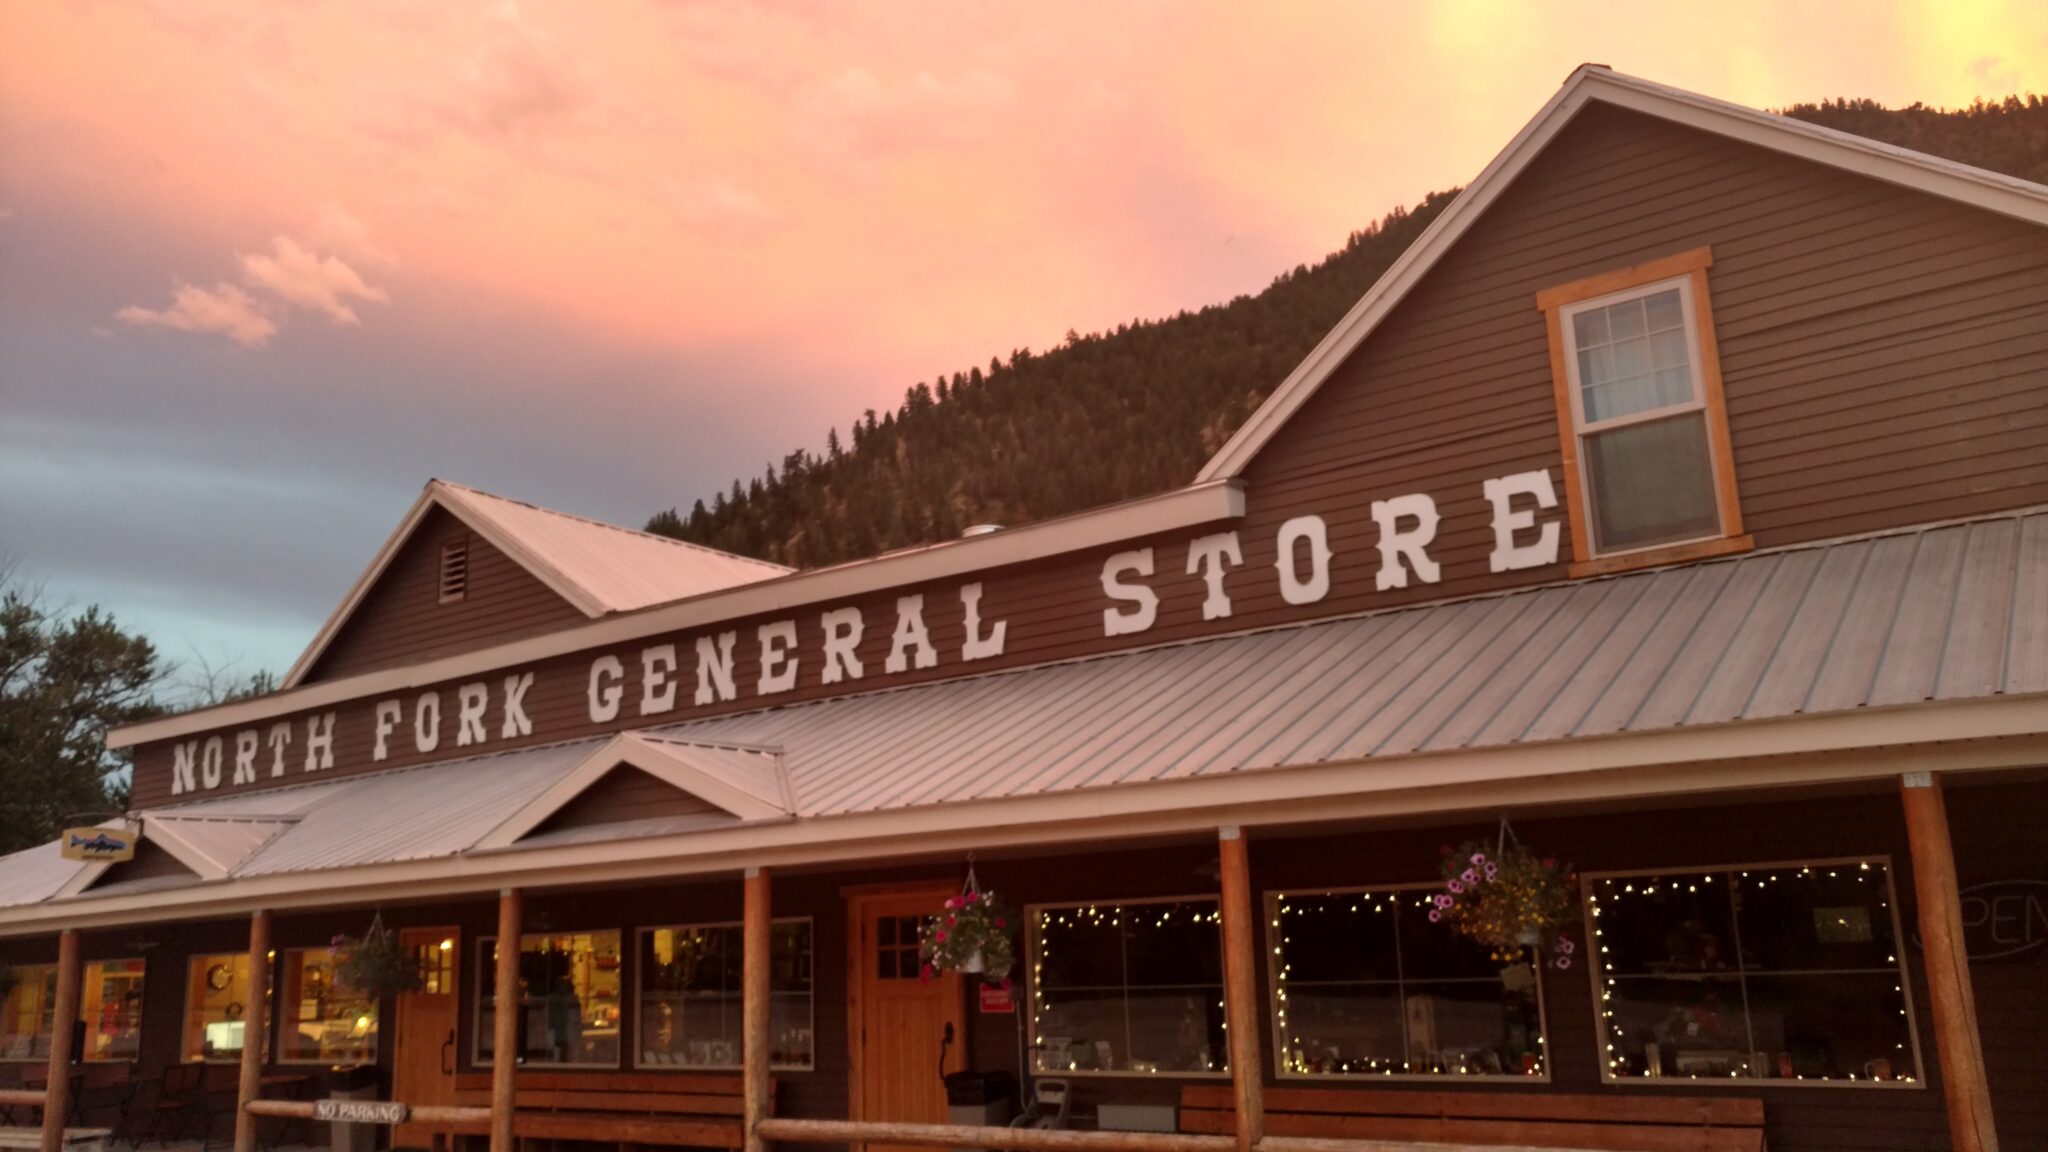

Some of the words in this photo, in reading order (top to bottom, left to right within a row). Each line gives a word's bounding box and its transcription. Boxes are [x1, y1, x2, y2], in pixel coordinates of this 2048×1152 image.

[171, 711, 336, 795] NORTH
[373, 672, 534, 761] FORK
[587, 582, 1007, 723] GENERAL
[1100, 468, 1561, 636] STORE
[1960, 894, 2048, 944] PEN
[317, 1100, 336, 1119] NO
[338, 1102, 401, 1122] PARKING
